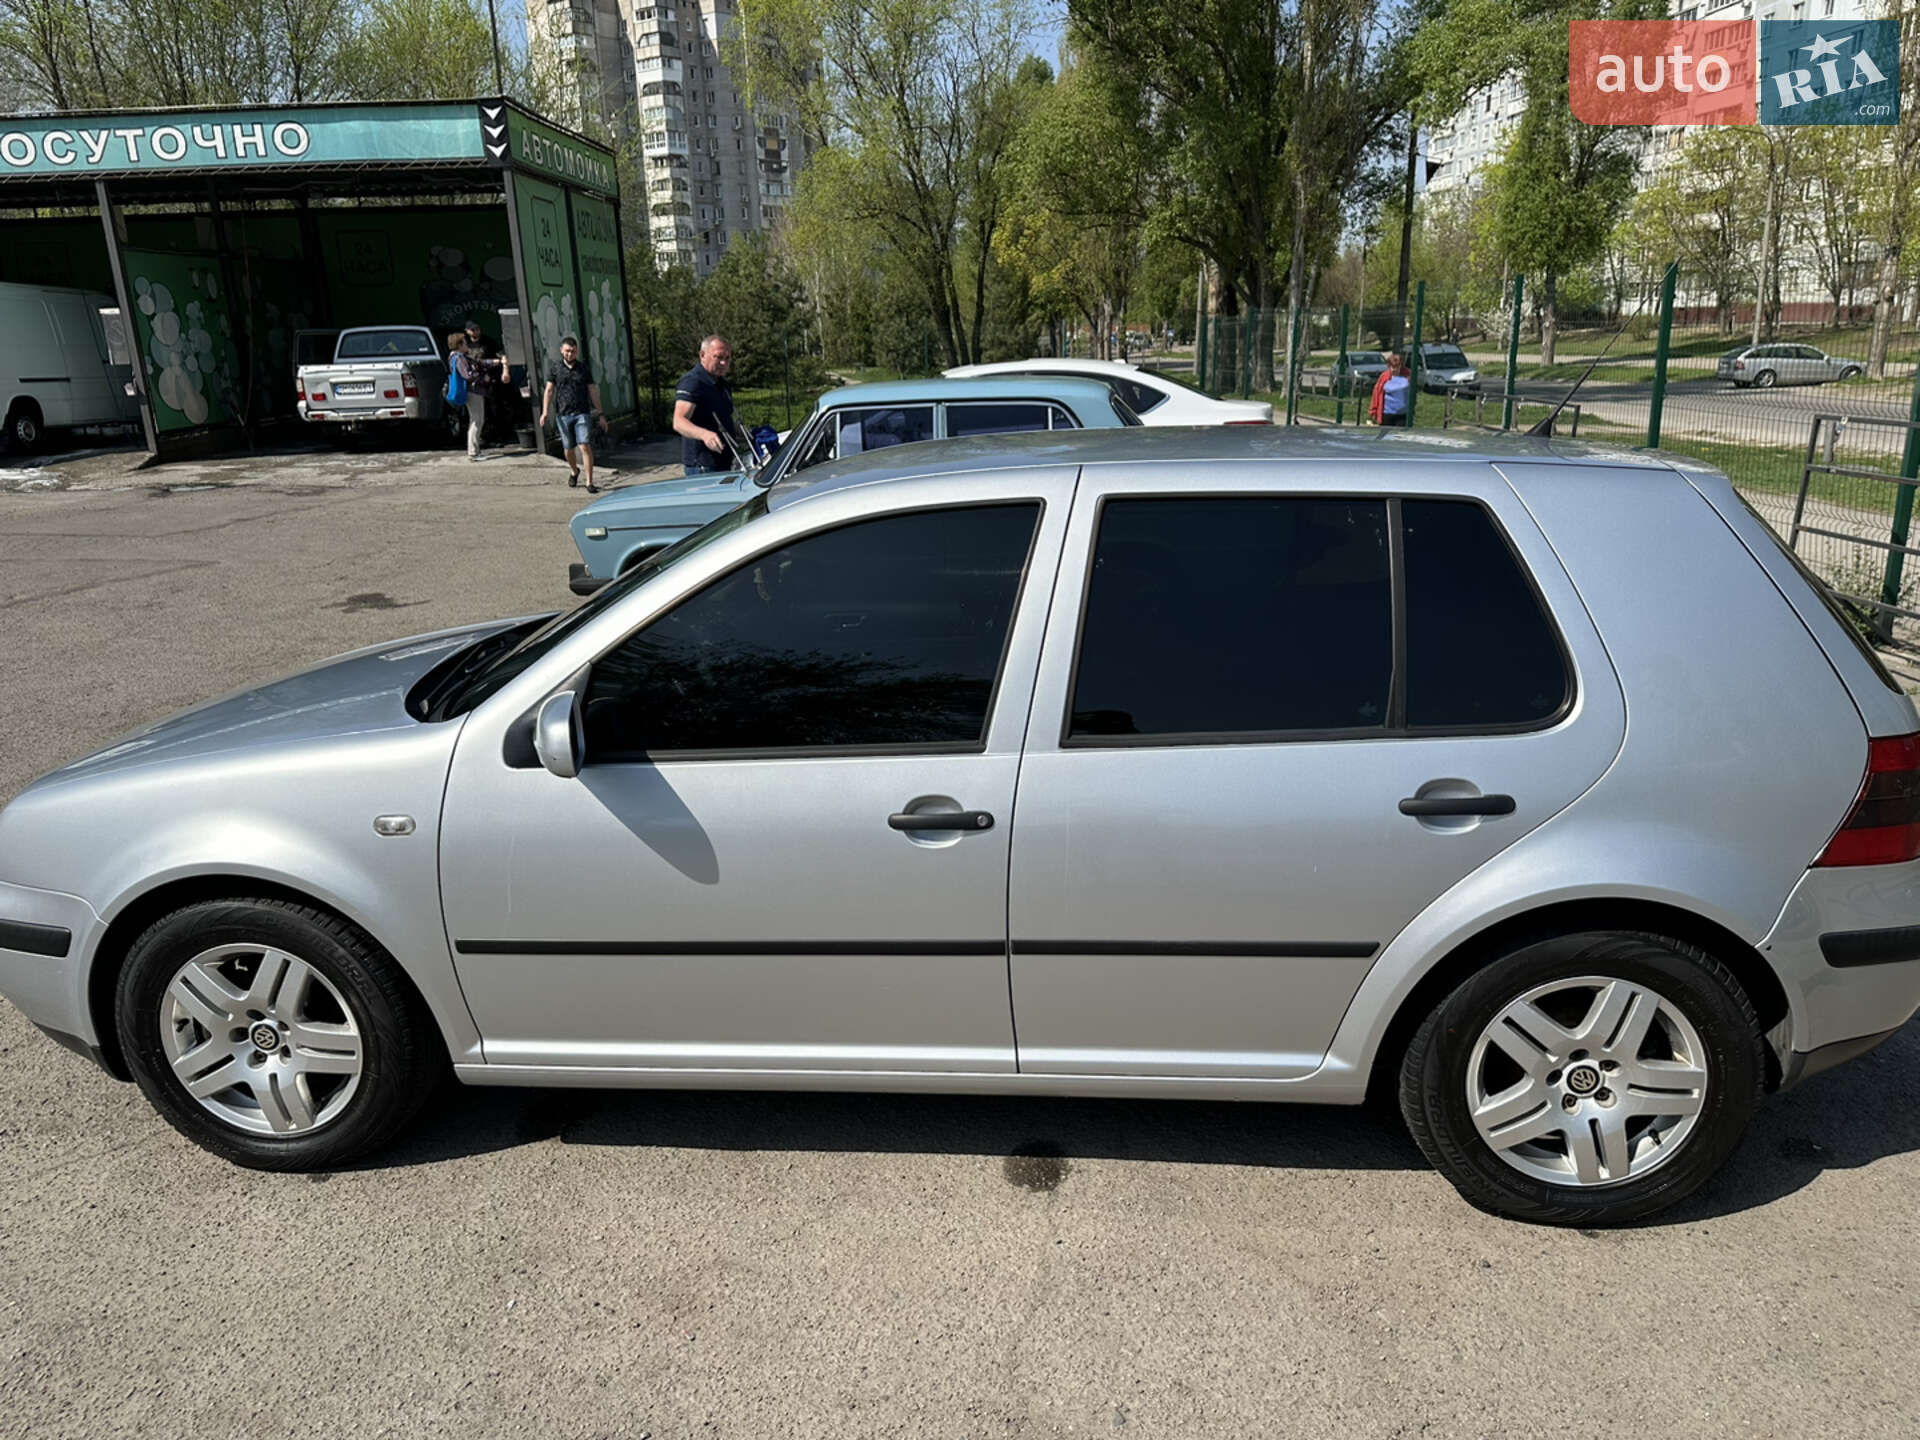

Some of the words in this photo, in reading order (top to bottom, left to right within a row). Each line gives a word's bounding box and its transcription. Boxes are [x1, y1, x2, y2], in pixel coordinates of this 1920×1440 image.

[0, 121, 310, 167] ОСУТОЧНО
[522, 129, 611, 189] АВТОМОЙКА
[541, 217, 552, 239] 24
[354, 241, 373, 256] 24
[538, 247, 561, 268] ЧАСА
